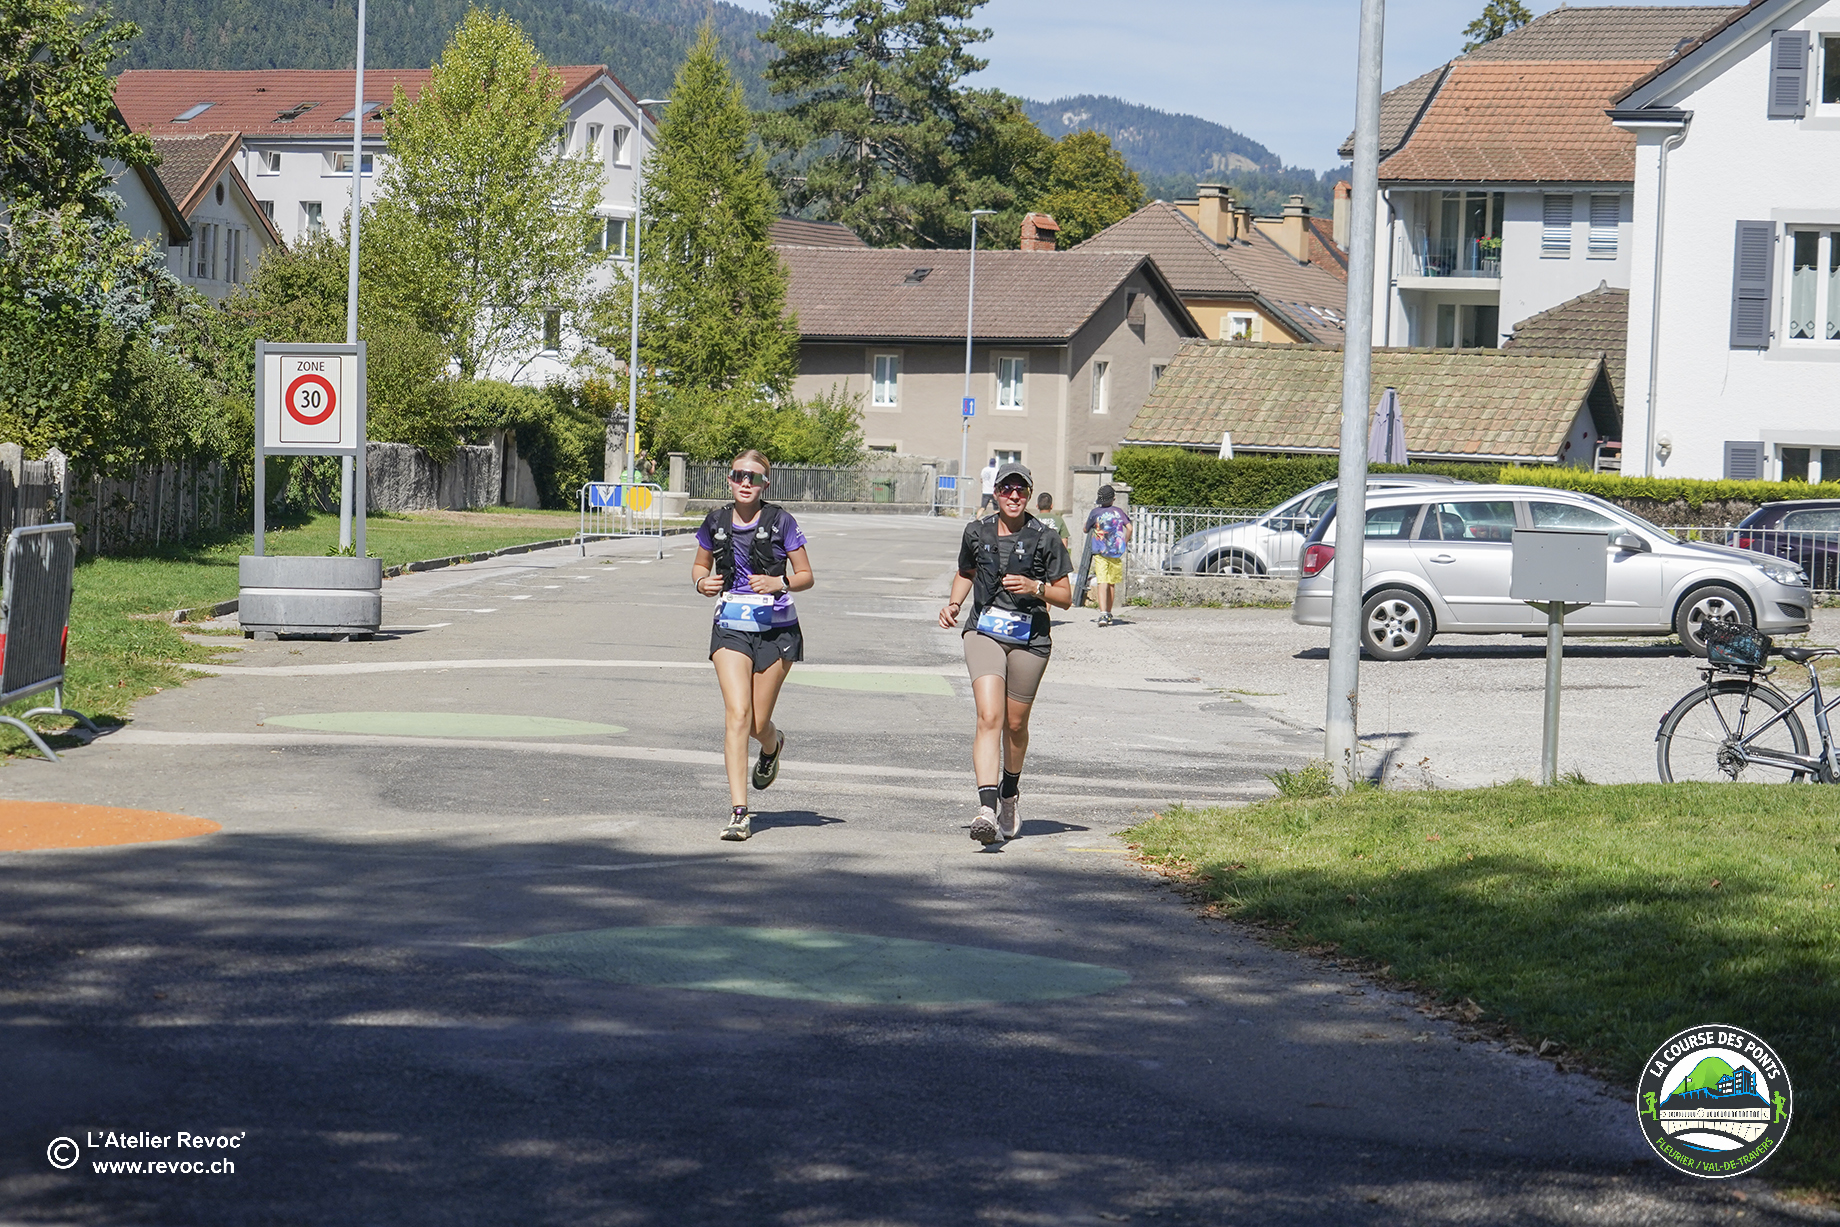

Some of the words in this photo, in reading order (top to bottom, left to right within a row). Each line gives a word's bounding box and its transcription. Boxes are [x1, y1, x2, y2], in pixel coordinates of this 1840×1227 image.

[297, 361, 325, 372] ZONE
[300, 390, 321, 409] 30
[740, 604, 752, 620] 2
